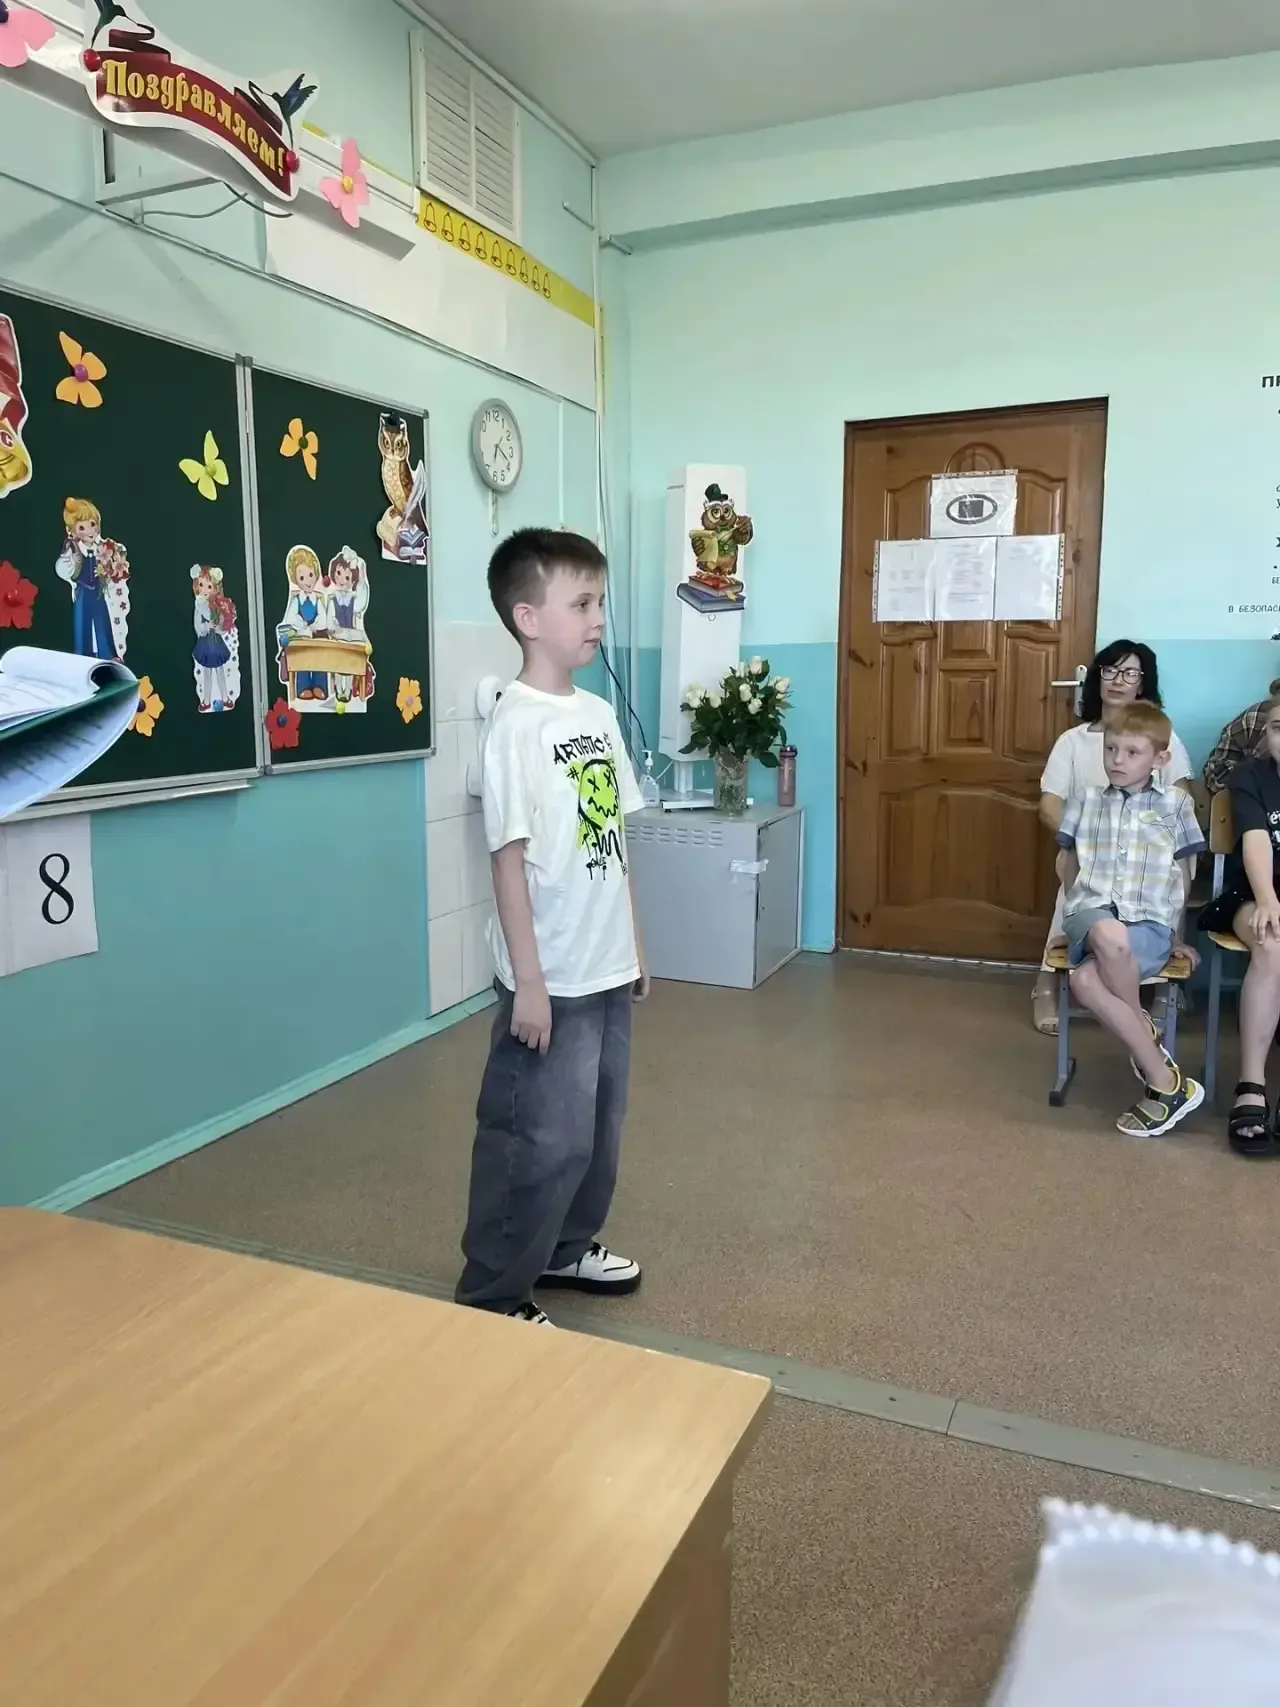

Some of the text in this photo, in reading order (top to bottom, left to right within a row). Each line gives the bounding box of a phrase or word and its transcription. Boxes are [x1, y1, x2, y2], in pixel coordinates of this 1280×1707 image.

[102, 59, 285, 178] Поздравляем!
[492, 409, 500, 422] 12
[506, 429, 511, 441] 2
[509, 446, 514, 458] 3
[492, 470, 498, 482] 6
[500, 469, 505, 481] 5
[39, 853, 75, 925] 8
